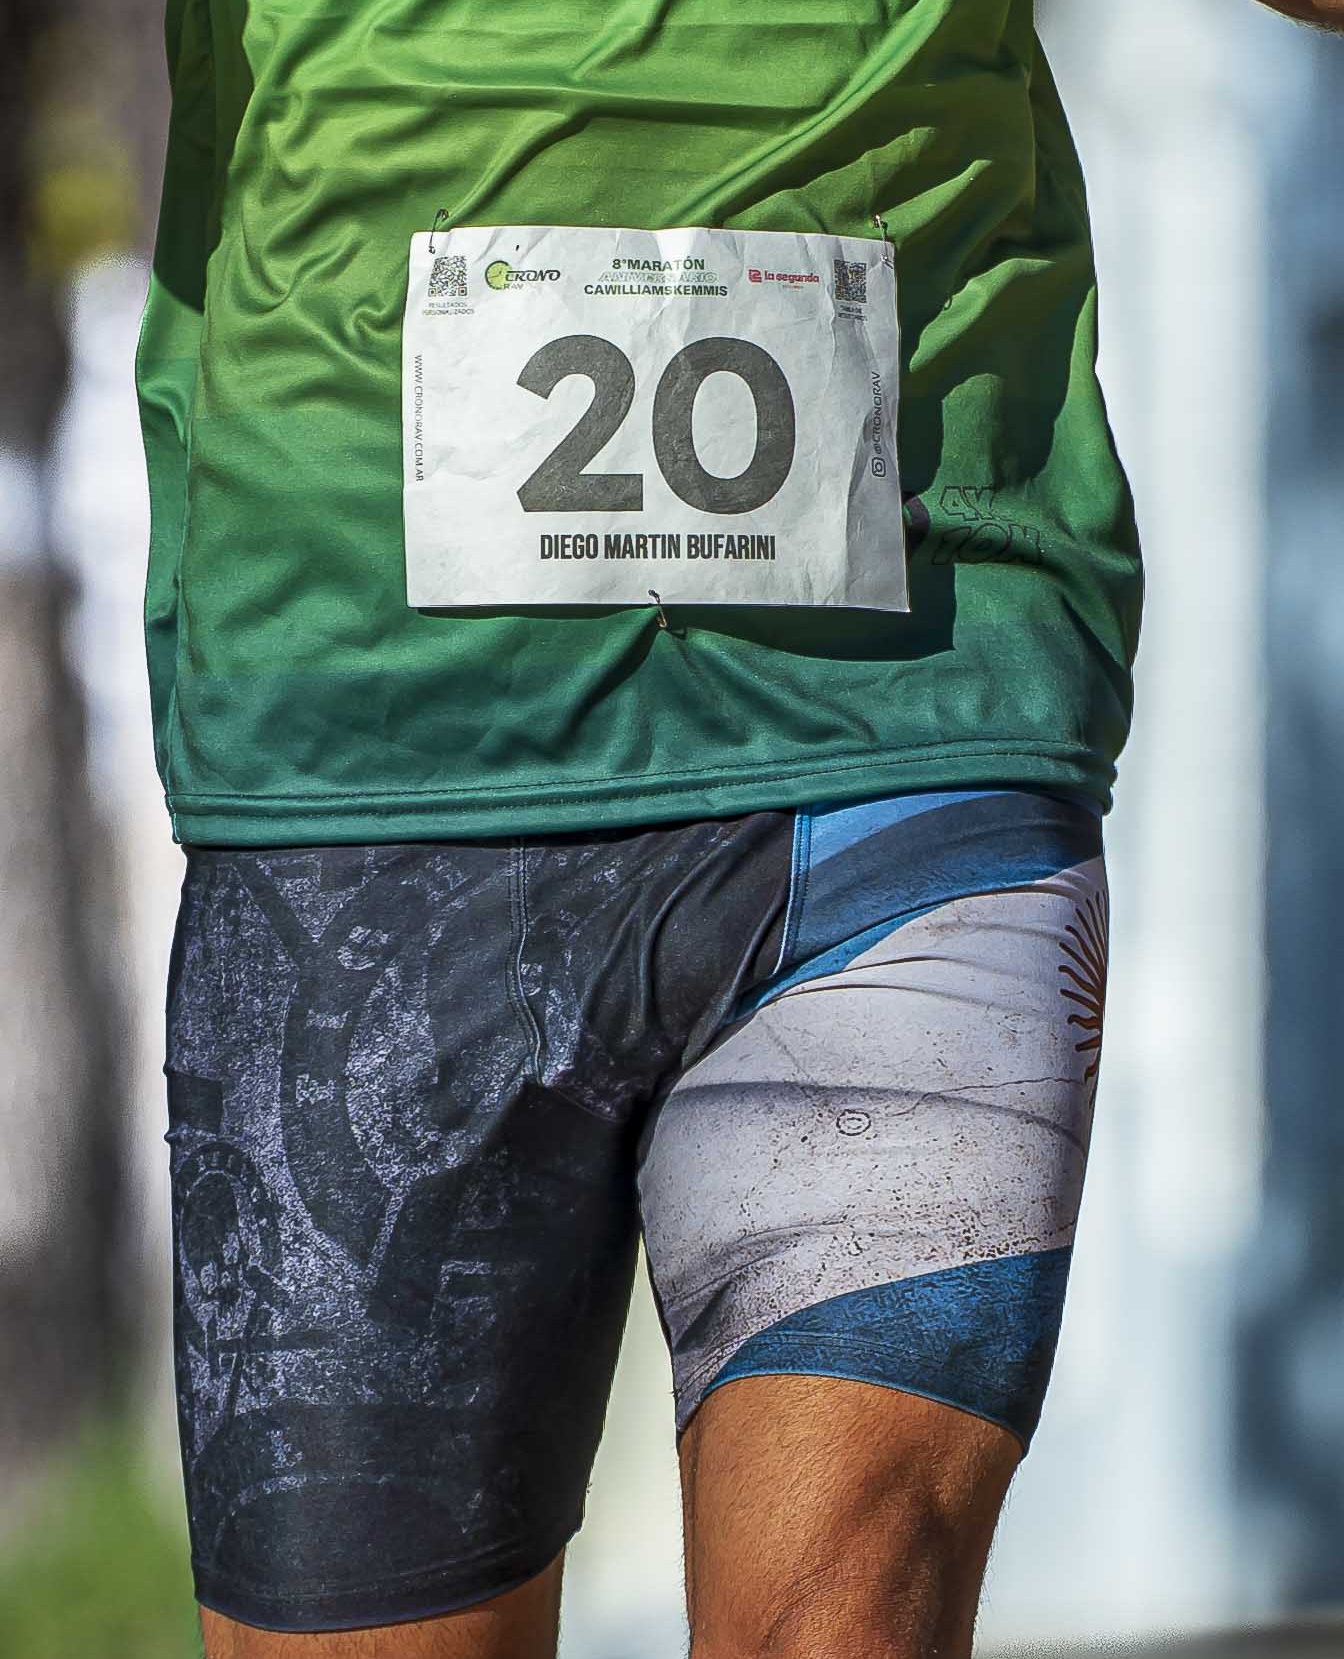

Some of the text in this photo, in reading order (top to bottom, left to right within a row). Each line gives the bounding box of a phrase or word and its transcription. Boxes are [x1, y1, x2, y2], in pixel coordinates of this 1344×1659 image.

[584, 284, 729, 297] CAWILLIAMSKEMMIS
[516, 334, 796, 515] 20
[540, 534, 776, 560] DIEGO MARTIN BUFARINI
